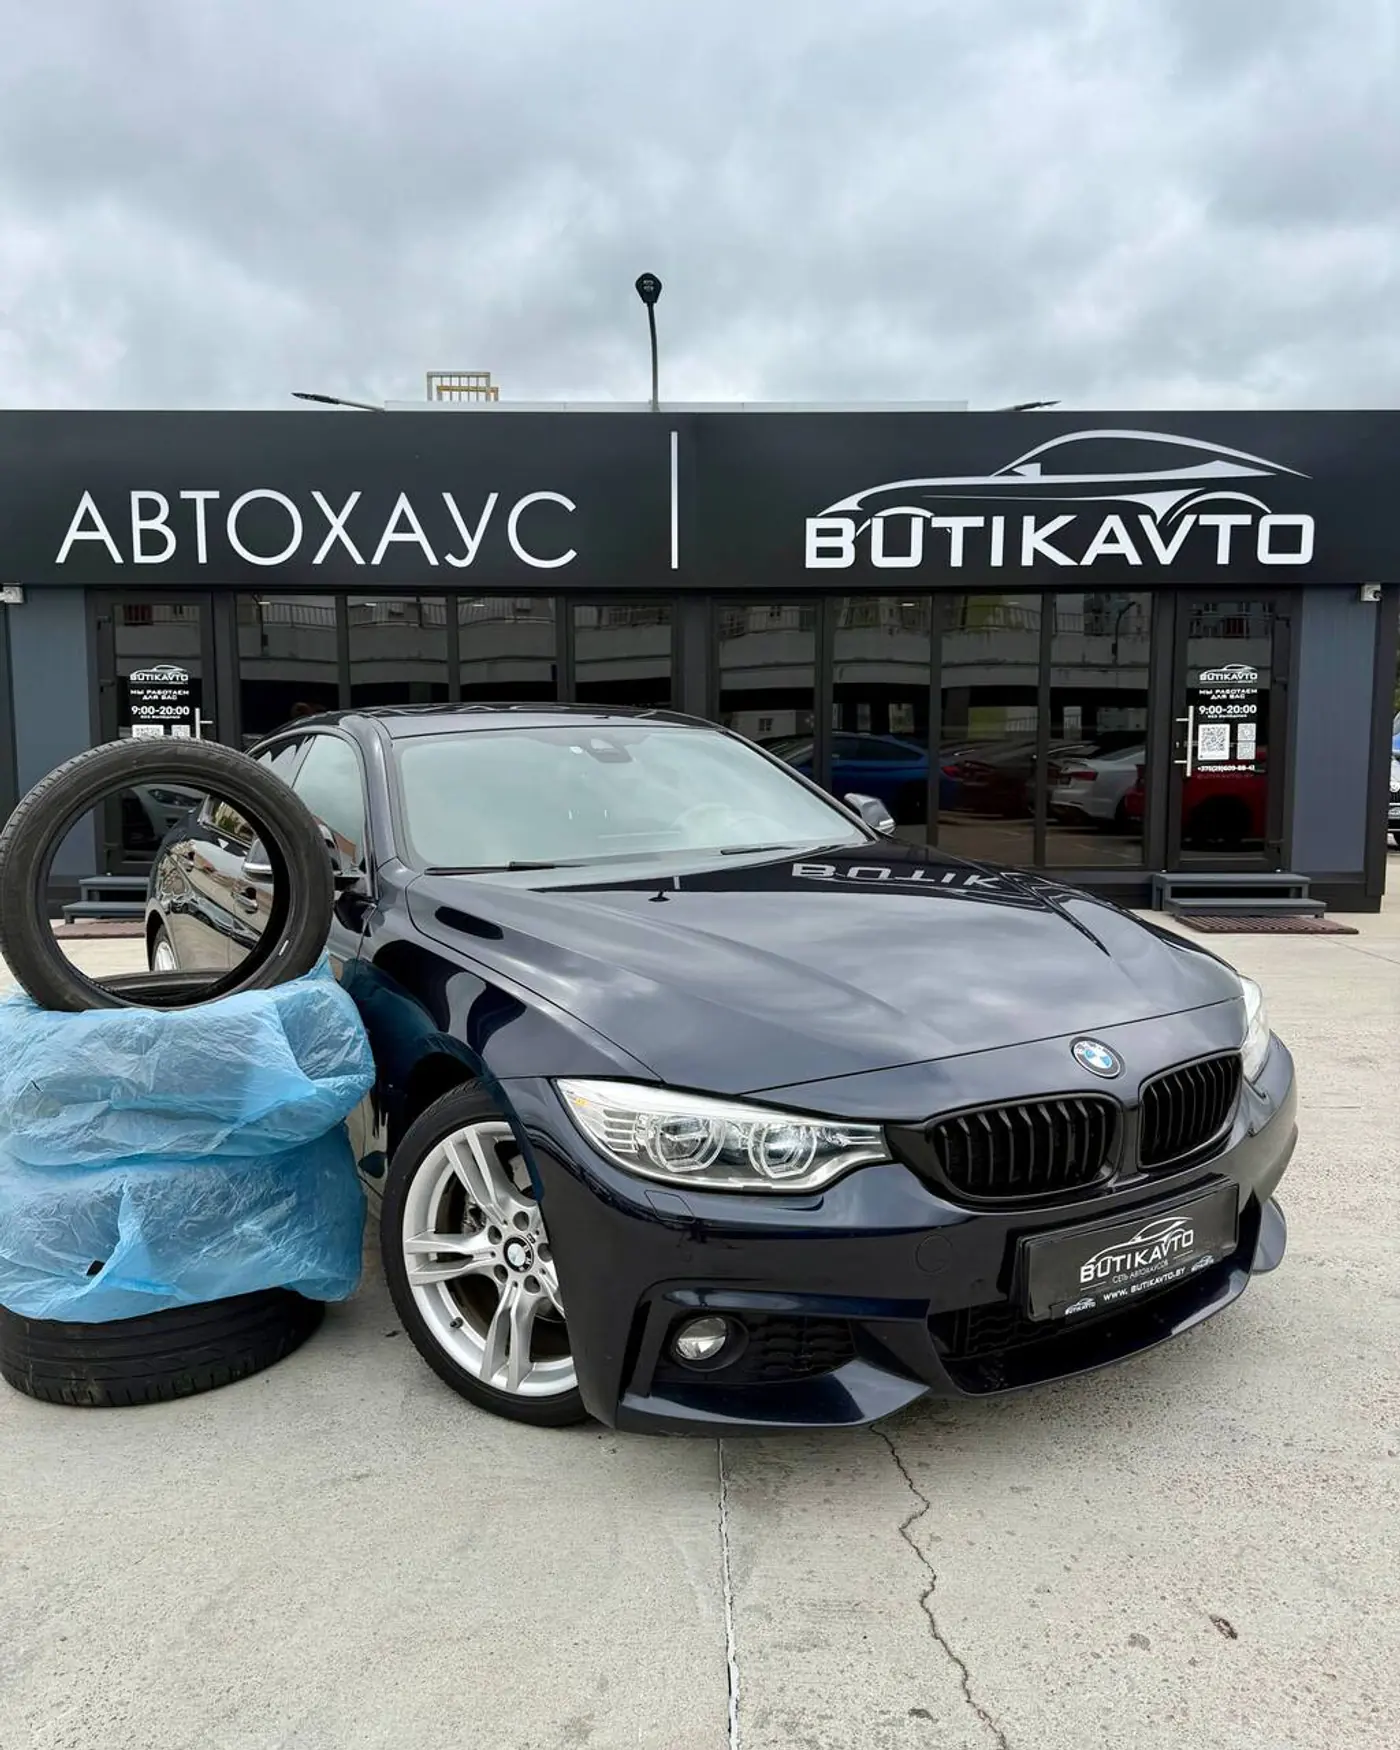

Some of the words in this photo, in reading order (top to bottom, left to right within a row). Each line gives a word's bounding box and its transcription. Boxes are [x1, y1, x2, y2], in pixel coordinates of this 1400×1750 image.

[55, 489, 578, 569] АВТОХАУС
[805, 512, 1316, 569] BUTIKAVTO
[130, 673, 189, 681] BUTIKAVTO
[1199, 673, 1258, 681] BUTIKAVTO
[131, 705, 190, 715] 9:00-20:00
[1199, 705, 1257, 715] 9:00-20:00
[1080, 1229, 1195, 1283] BUTIKAVTO
